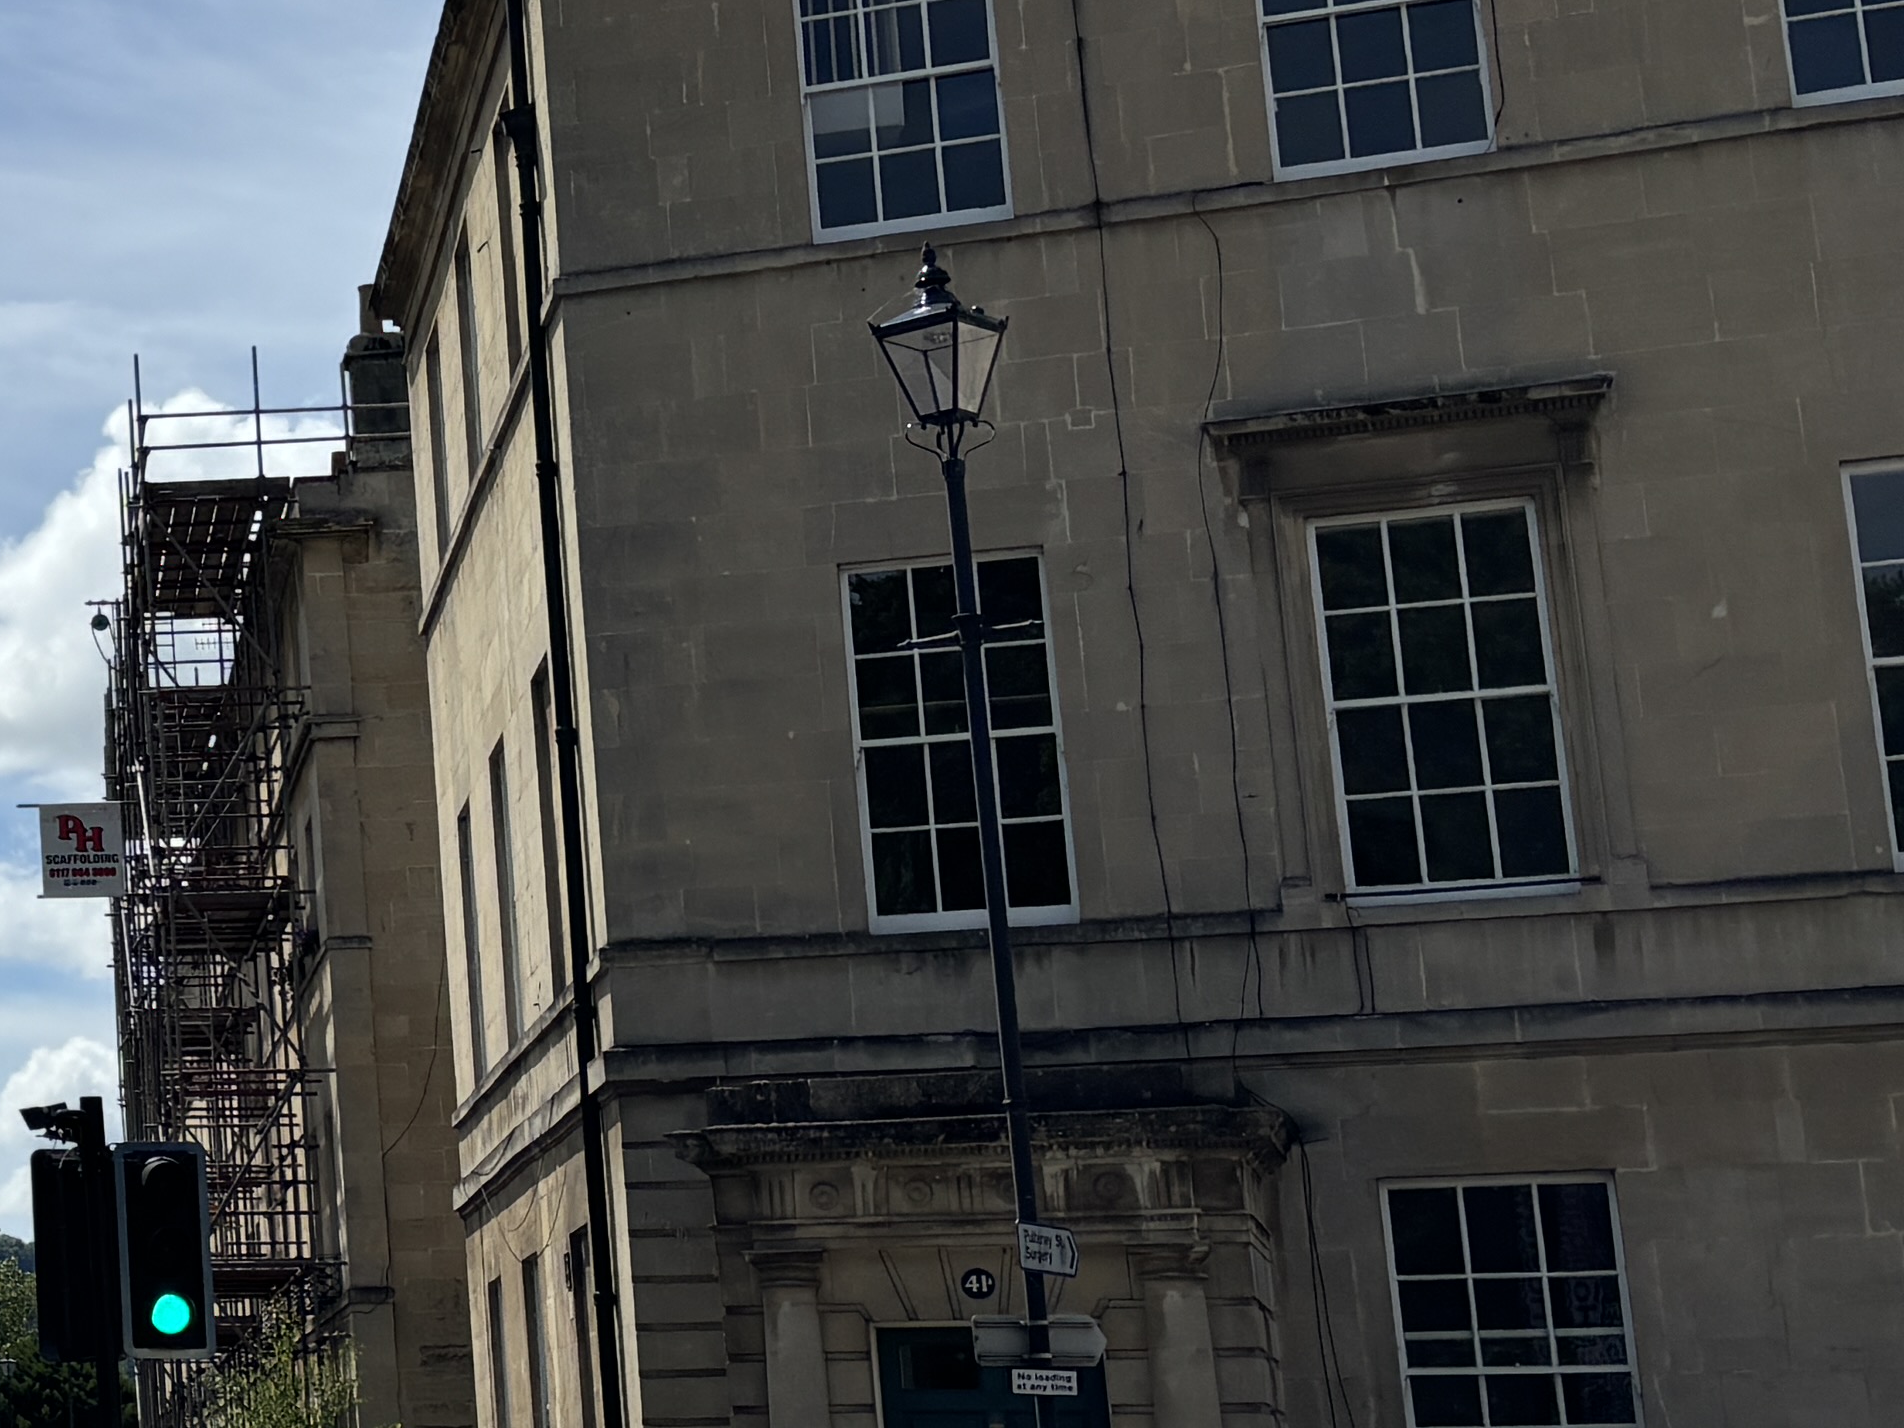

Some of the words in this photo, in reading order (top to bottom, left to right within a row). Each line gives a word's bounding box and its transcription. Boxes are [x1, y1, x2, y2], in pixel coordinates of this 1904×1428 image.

[46, 854, 119, 864] SCAFFOLDING
[1026, 1246, 1052, 1265] Surgery
[1017, 1372, 1031, 1380] No
[1034, 1372, 1072, 1383] loading
[1030, 1383, 1047, 1391] any
[1051, 1383, 1073, 1391] time
